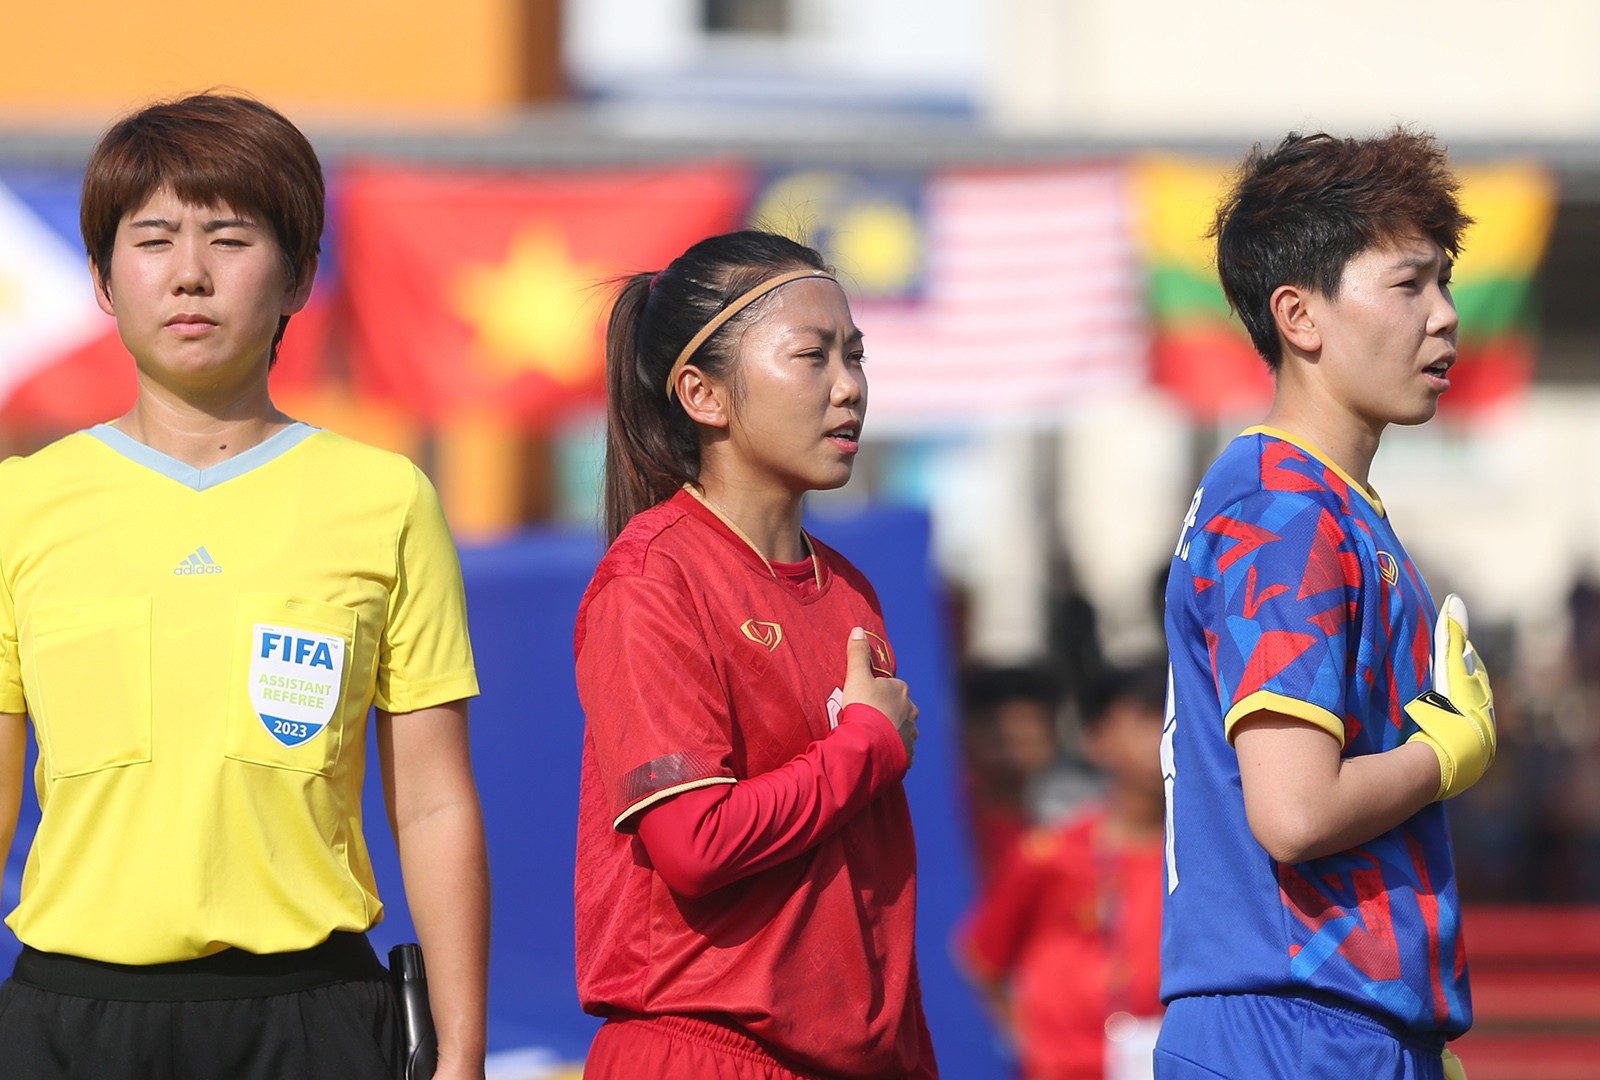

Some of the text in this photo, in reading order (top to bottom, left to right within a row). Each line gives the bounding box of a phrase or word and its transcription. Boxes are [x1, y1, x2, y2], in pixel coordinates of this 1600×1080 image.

[173, 563, 223, 576] adidas
[260, 632, 334, 671] FIFA
[258, 673, 332, 696] ASSISTANT
[263, 688, 325, 709] REFEREE
[273, 720, 308, 738] 2023
